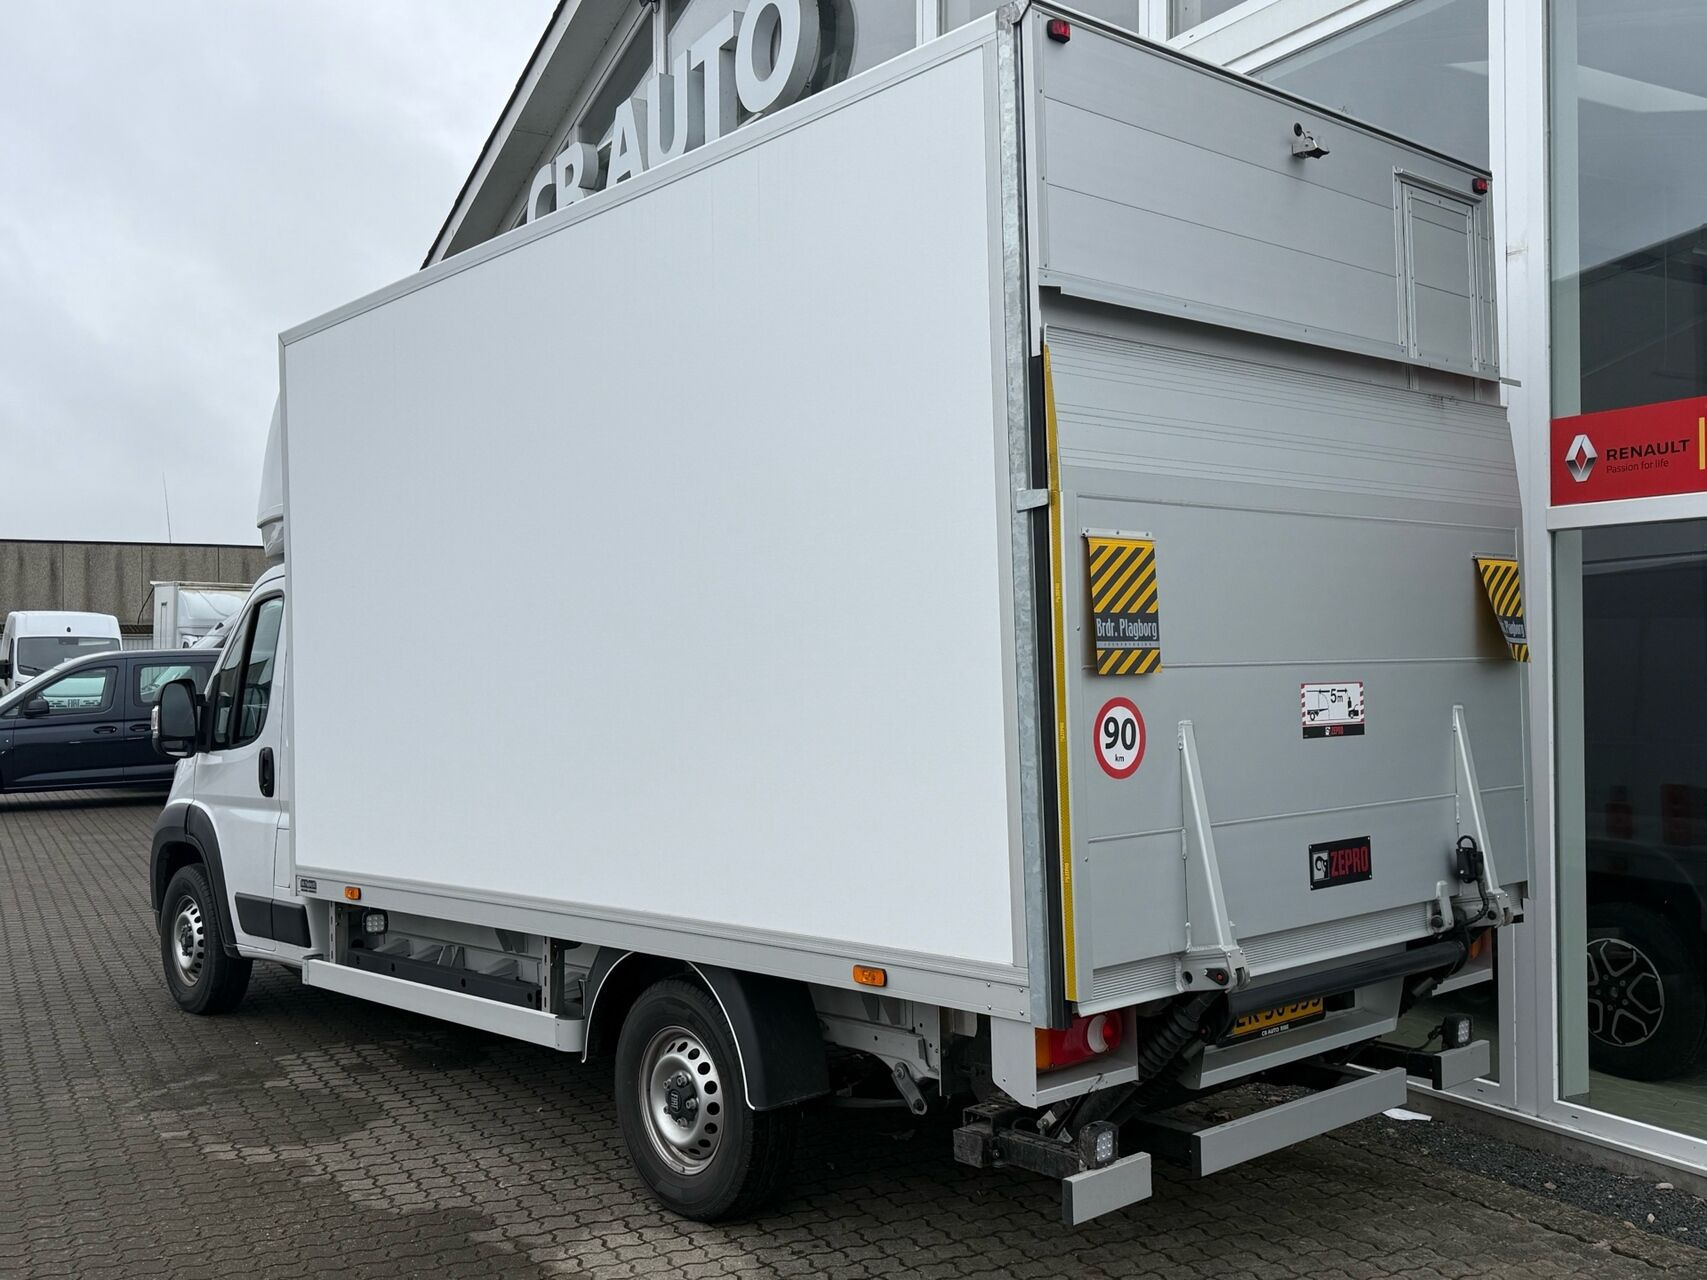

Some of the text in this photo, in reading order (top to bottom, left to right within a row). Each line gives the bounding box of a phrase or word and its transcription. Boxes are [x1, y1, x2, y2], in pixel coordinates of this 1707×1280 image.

[606, 0, 803, 190] AUTO
[1606, 439, 1691, 461] RENAULT
[1606, 458, 1670, 474] Passion for life
[1096, 617, 1158, 640] Brdr. Plagborg
[1103, 716, 1137, 751] 90
[1114, 754, 1125, 762] km
[1330, 846, 1369, 878] ZEPRO
